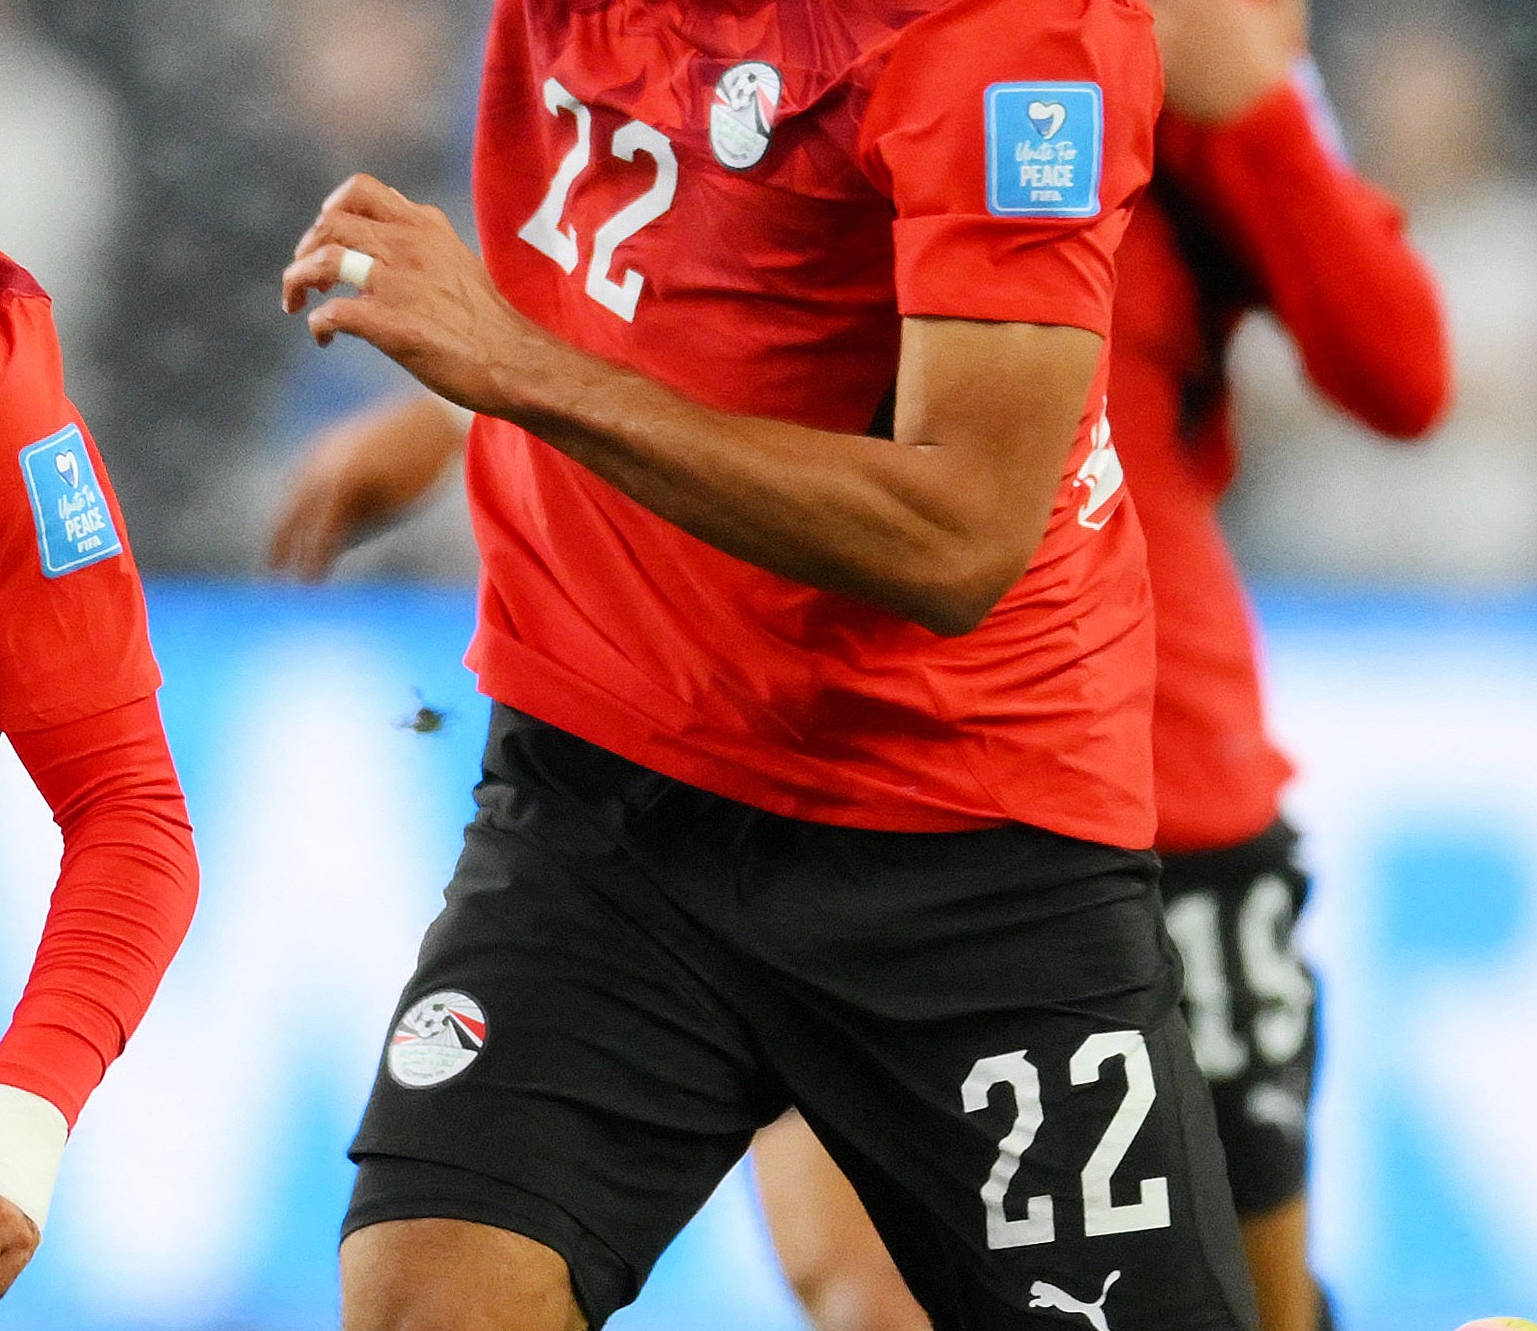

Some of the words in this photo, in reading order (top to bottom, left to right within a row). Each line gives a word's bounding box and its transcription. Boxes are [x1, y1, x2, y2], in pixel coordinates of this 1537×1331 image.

[517, 77, 679, 324] 22
[1019, 165, 1075, 187] PEACE
[65, 508, 106, 542] PEACE
[960, 1029, 1172, 1251] 22
